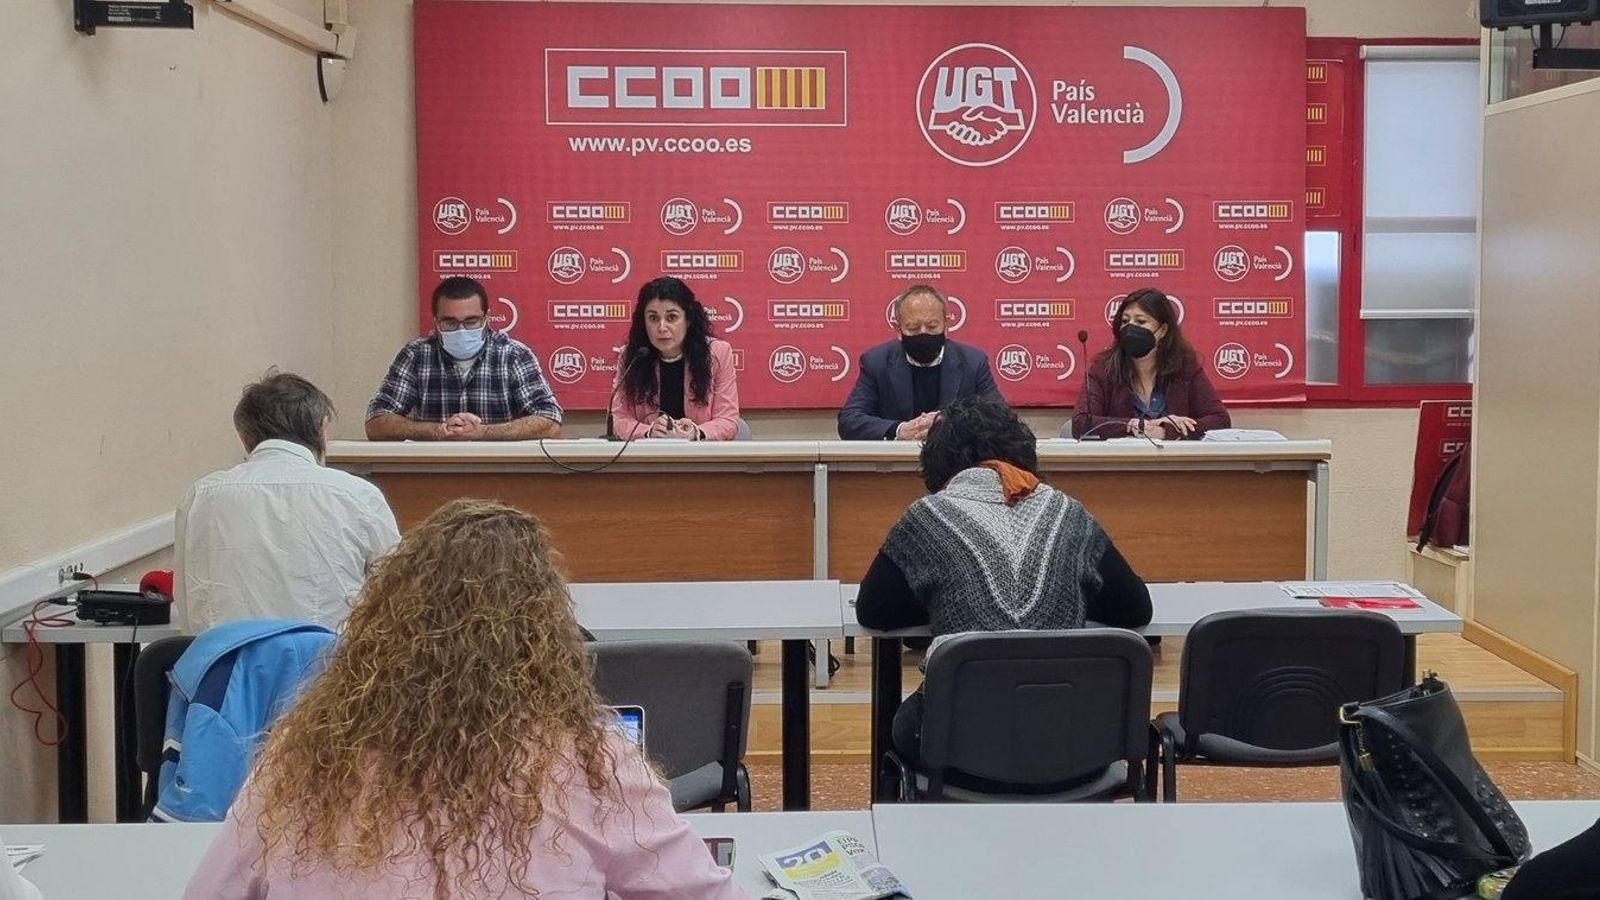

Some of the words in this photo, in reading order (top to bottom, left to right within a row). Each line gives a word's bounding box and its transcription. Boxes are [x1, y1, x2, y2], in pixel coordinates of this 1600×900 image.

[567, 66, 751, 108] CCOO
[934, 67, 1018, 113] UGT
[1052, 79, 1095, 101] País
[1051, 103, 1145, 124] Valencià
[568, 137, 752, 156] www.pv.ccoo.es
[439, 204, 465, 219] UGT
[553, 206, 604, 218] CCOO
[667, 205, 693, 219] UGT
[773, 206, 823, 218] CCOO
[891, 205, 916, 219] UGT
[1001, 206, 1049, 218] CCOO
[1109, 204, 1135, 218] UGT
[1219, 205, 1267, 217] CCOO
[439, 255, 491, 266] CCOO
[554, 254, 580, 268] UGT
[667, 255, 717, 266] CCOO
[774, 254, 800, 268] UGT
[891, 255, 942, 266] CCOO
[1001, 253, 1026, 267] UGT
[1110, 254, 1158, 266] CCOO
[1219, 253, 1244, 265] UGT
[554, 305, 605, 317] CCOO
[774, 305, 824, 316] CCOO
[1001, 304, 1049, 316] CCOO
[1219, 302, 1267, 314] CCOO
[708, 313, 732, 321] alencià
[554, 353, 581, 368] UGT
[775, 352, 800, 365] UGT
[1001, 351, 1027, 365] UGT
[1219, 350, 1245, 363] UGT
